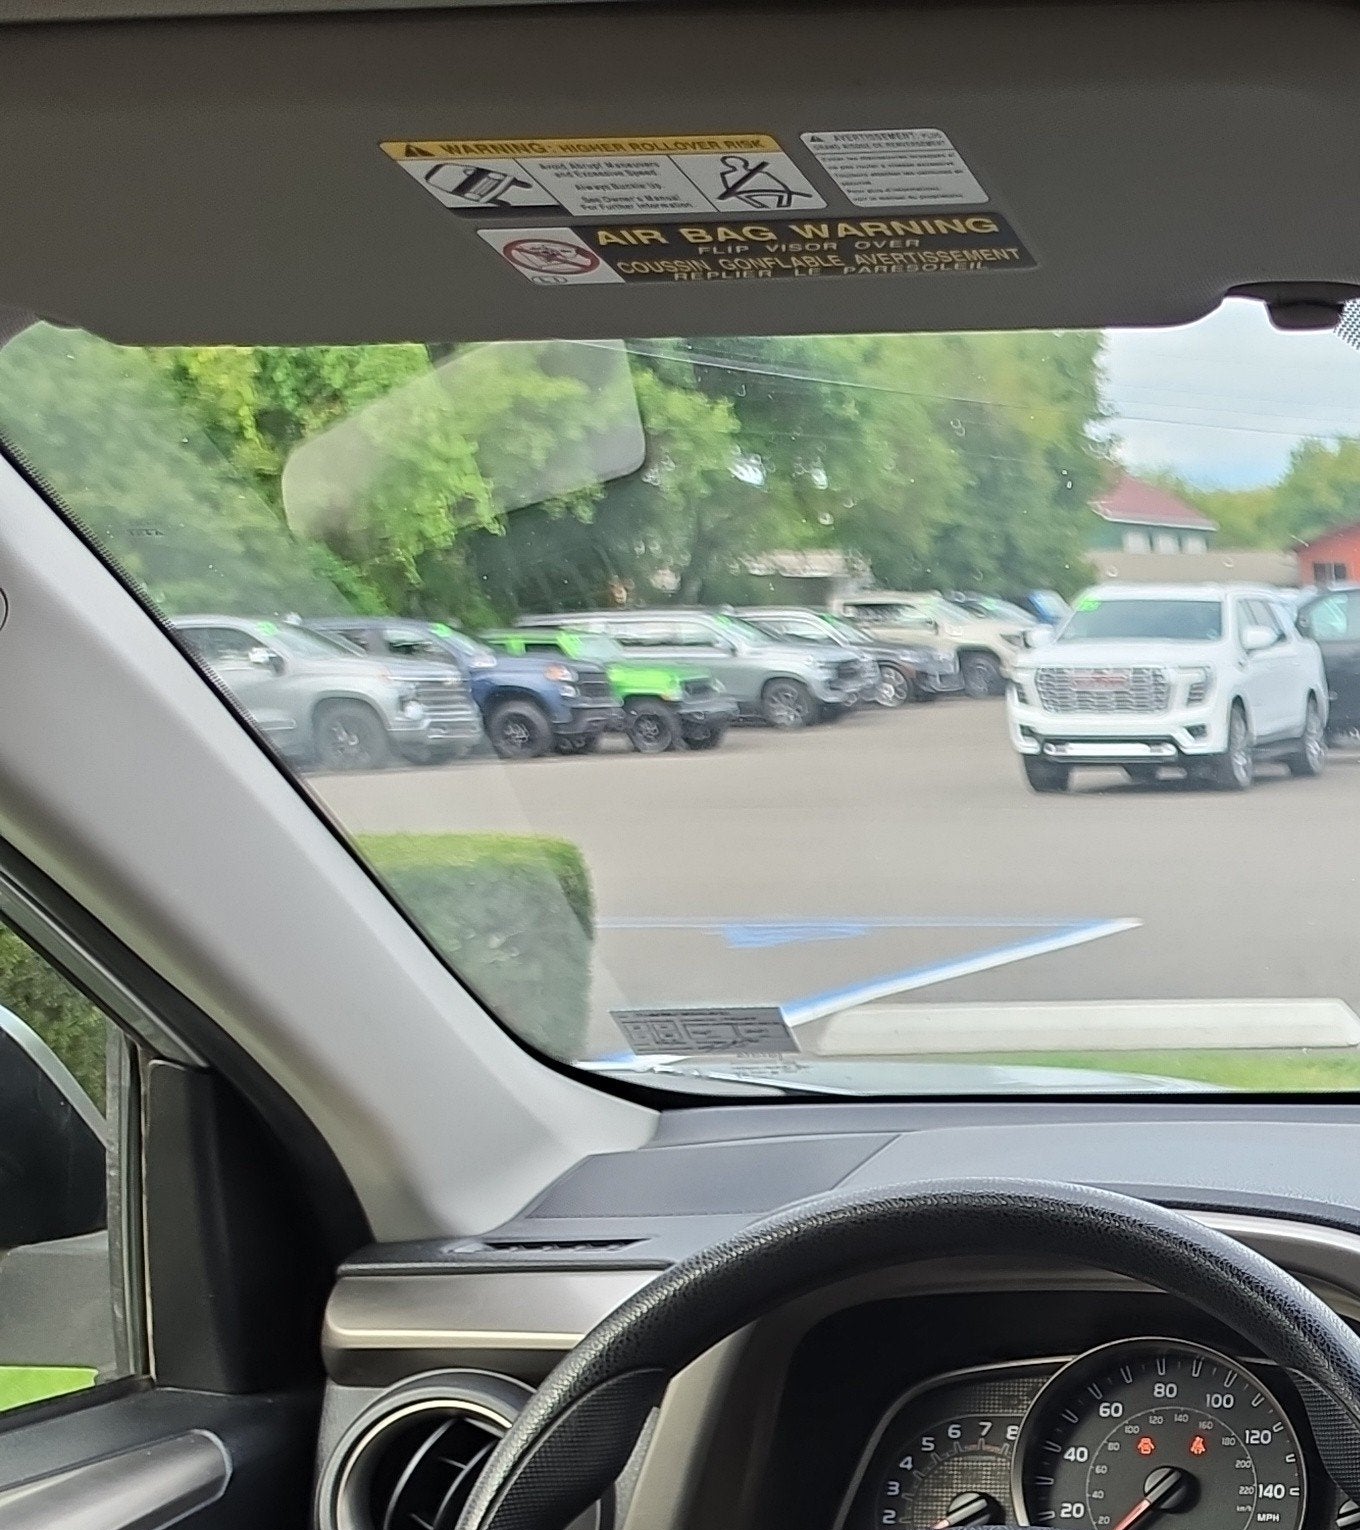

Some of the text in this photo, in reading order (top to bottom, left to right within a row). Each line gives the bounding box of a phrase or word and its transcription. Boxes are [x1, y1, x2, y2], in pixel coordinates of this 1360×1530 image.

[559, 141, 626, 153] HIGHER
[628, 140, 720, 152] ROLLOVER
[724, 138, 766, 150] RISK
[597, 217, 1000, 246] AIR BAG WARNING
[698, 239, 920, 255] FLIP VISOR OVER
[616, 248, 1020, 274] COUSSIN GONFLABLE AVERTISSEMENT
[674, 261, 986, 281] REPLIER LE PARESOLEIL
[1153, 1383, 1178, 1398] 80
[1206, 1394, 1235, 1409] 100
[1099, 1402, 1123, 1418] 60
[947, 1423, 962, 1439] 6
[979, 1421, 993, 1437] 7
[1006, 1425, 1020, 1441] 8
[1245, 1429, 1272, 1445] 120
[921, 1436, 935, 1452] 5
[1064, 1447, 1088, 1463] 40
[899, 1456, 913, 1471] 4
[1095, 1465, 1108, 1475] 60
[886, 1480, 900, 1496] 3
[1091, 1489, 1105, 1499] 40
[1238, 1486, 1254, 1495] 220
[1258, 1483, 1286, 1499] 140
[882, 1509, 897, 1525] 2
[1060, 1502, 1085, 1518] 20
[1257, 1513, 1280, 1523] MPH
